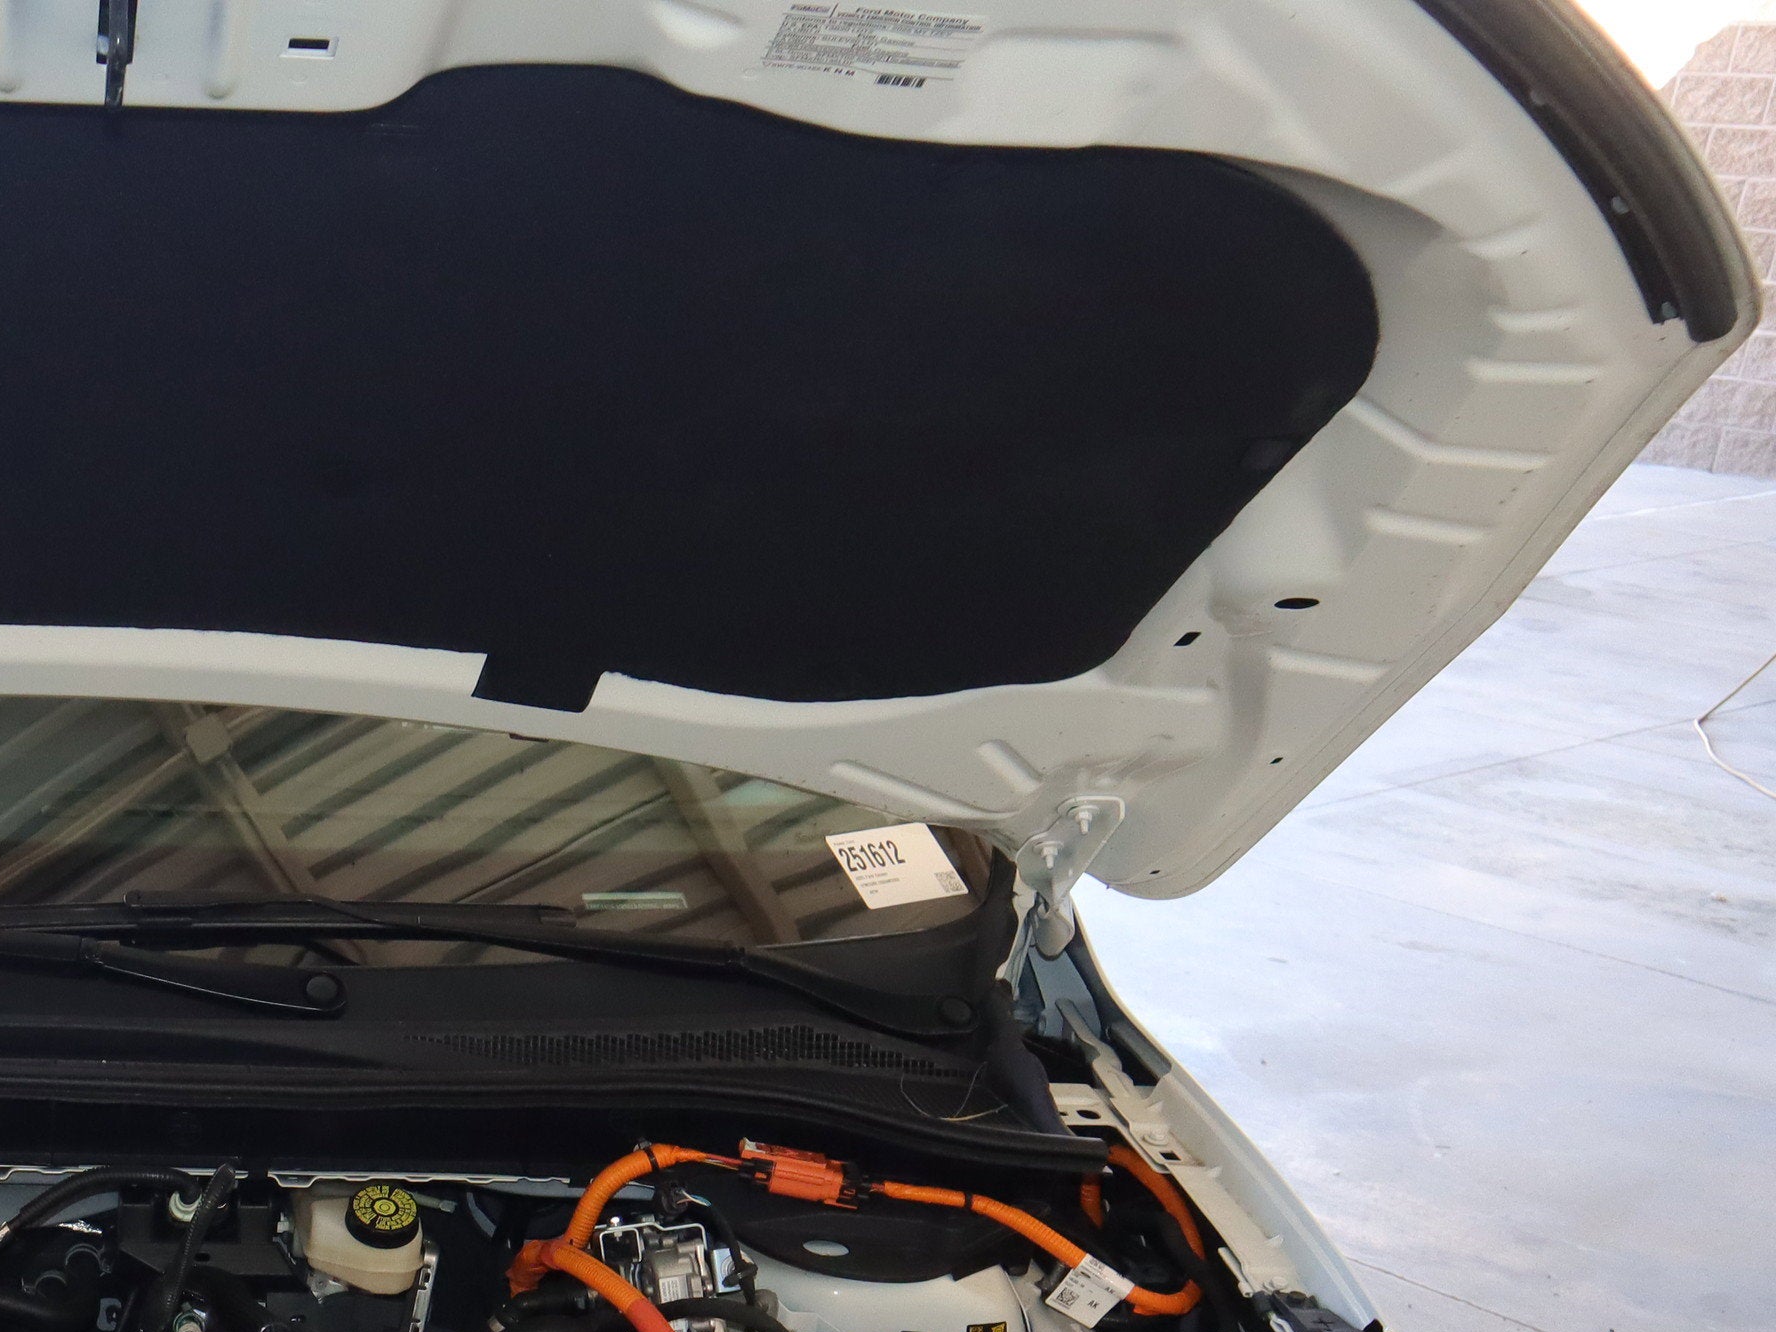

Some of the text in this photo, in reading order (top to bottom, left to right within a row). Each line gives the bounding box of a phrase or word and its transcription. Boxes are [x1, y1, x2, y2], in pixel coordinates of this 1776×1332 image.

[856, 6, 882, 15] Ford
[884, 10, 915, 19] Motor
[918, 14, 969, 25] Company
[839, 840, 906, 872] 251612
